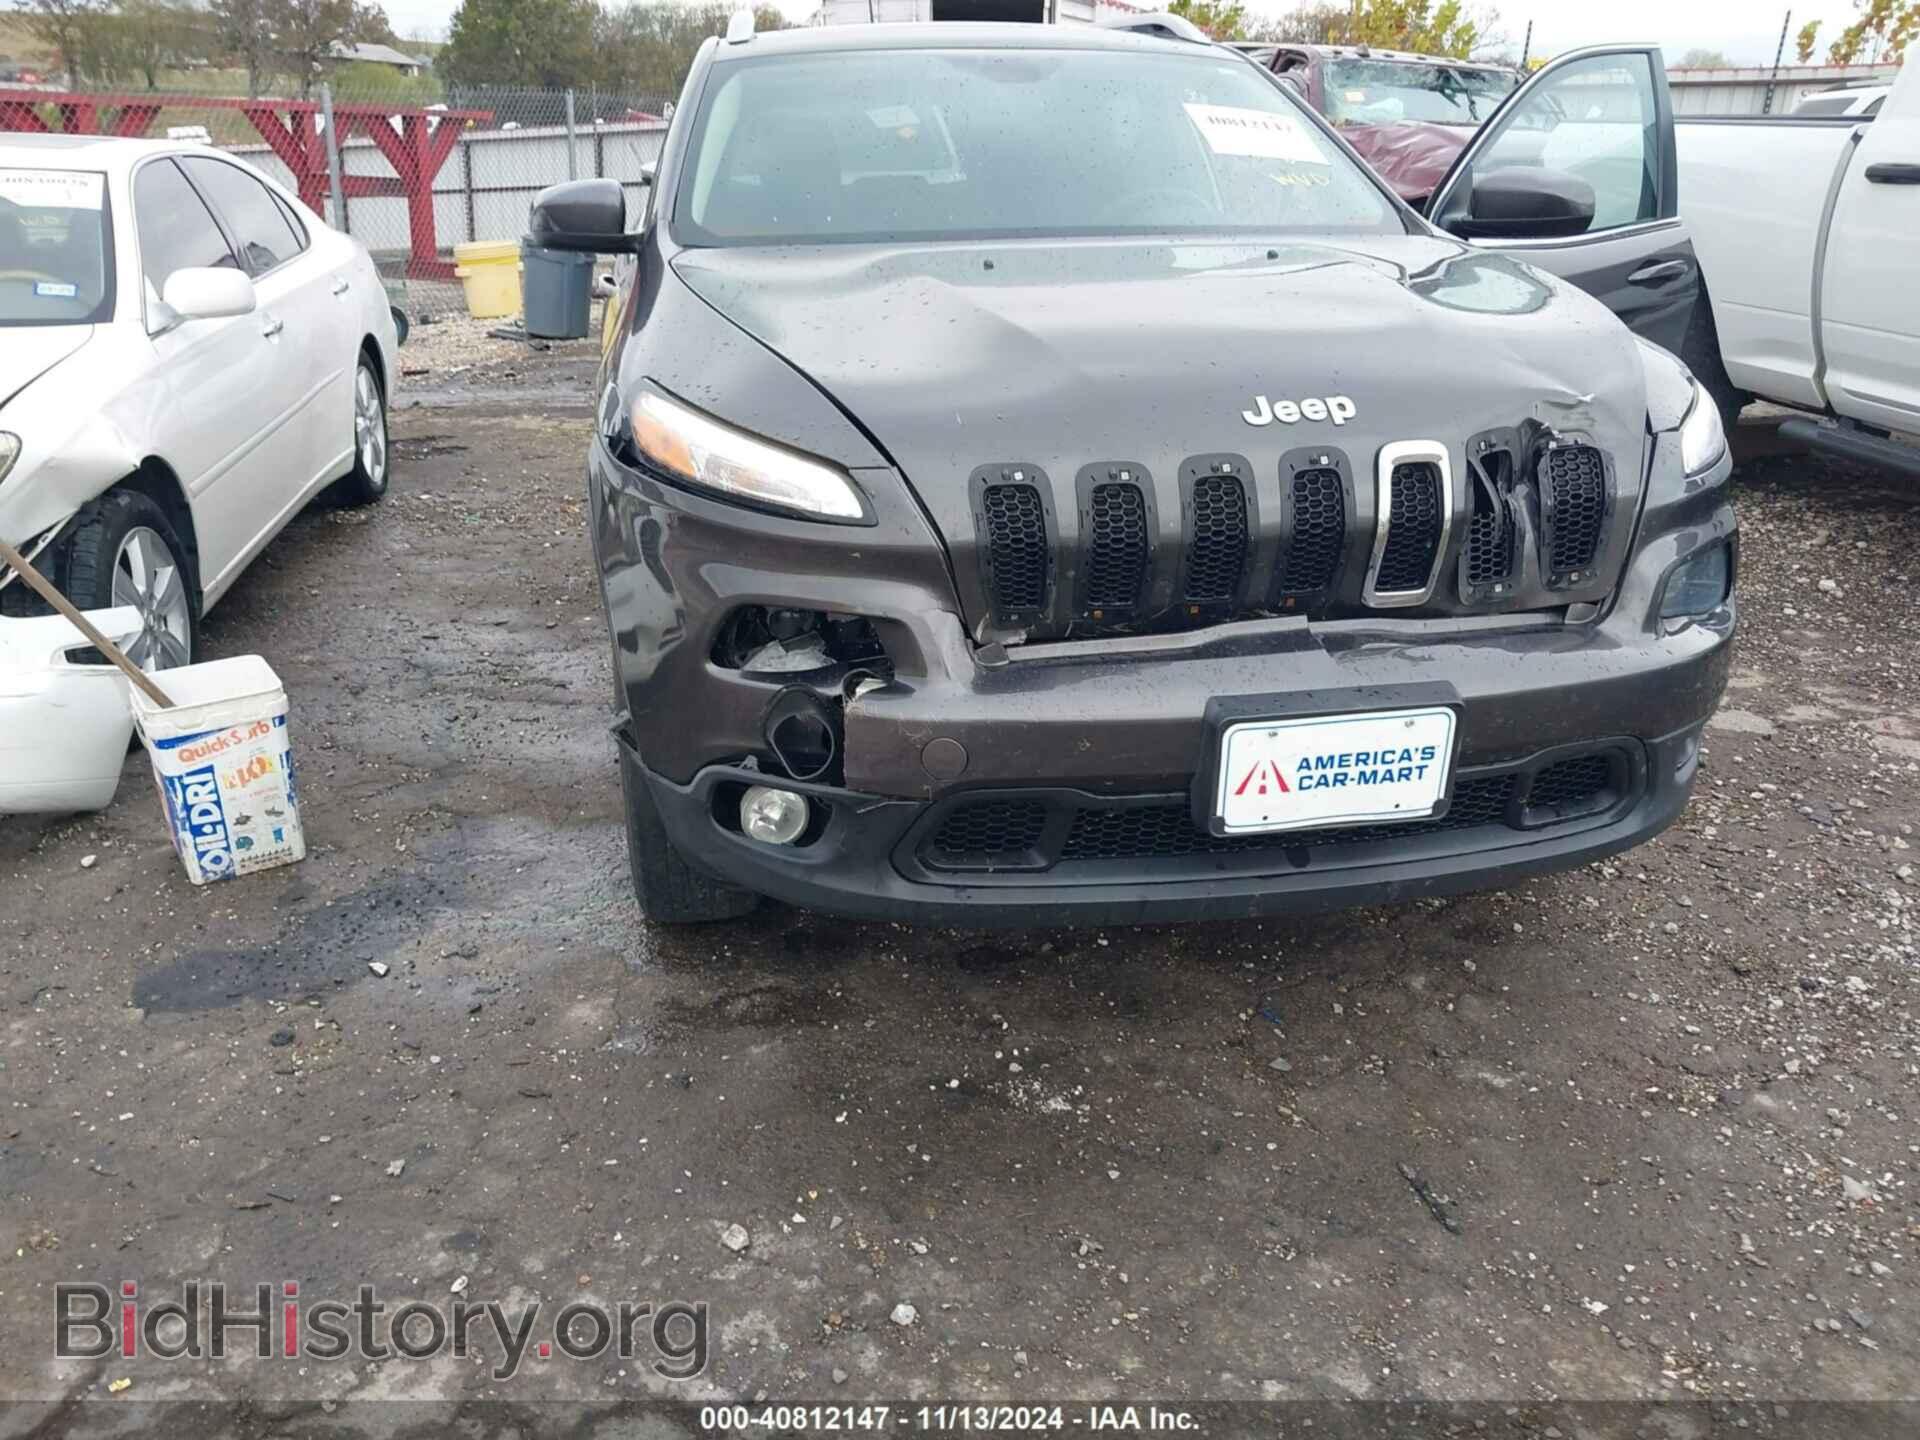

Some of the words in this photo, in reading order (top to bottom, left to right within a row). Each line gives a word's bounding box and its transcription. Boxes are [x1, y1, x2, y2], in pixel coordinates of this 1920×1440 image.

[1241, 395, 1356, 426] Jeep
[178, 735, 230, 762] Quick
[1296, 746, 1436, 772] AMERICA'S
[1298, 765, 1429, 791] CAR-MART
